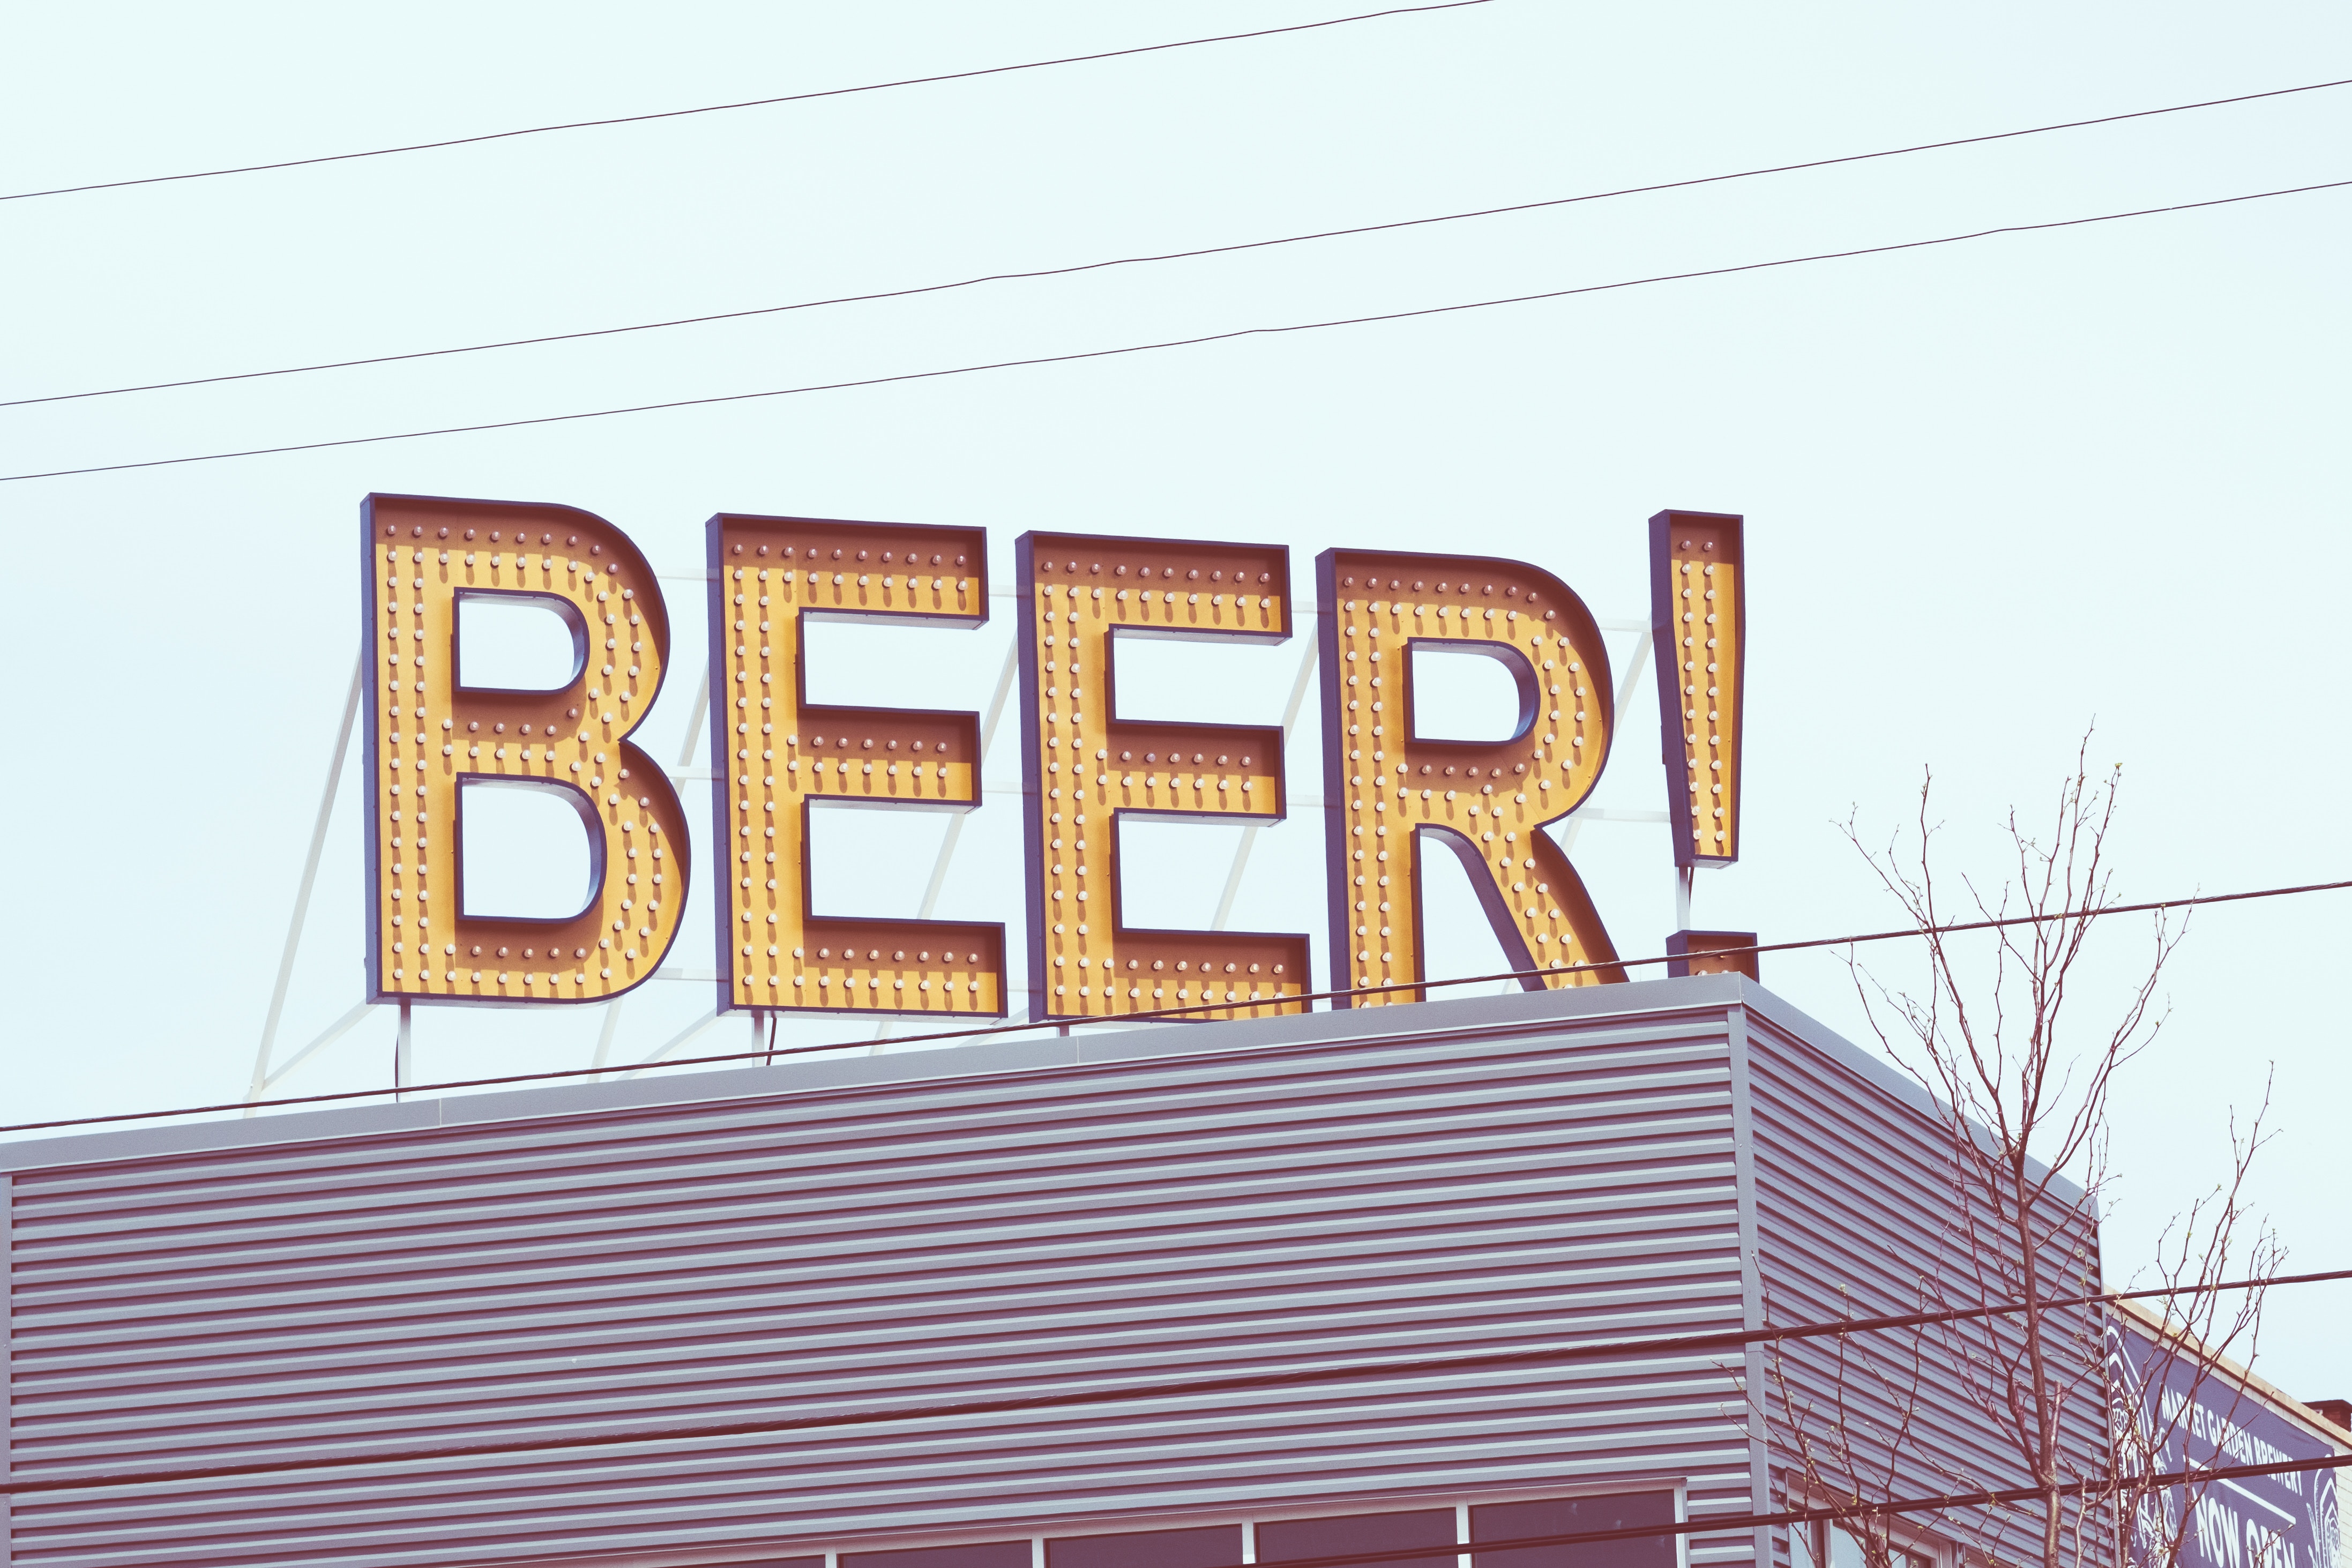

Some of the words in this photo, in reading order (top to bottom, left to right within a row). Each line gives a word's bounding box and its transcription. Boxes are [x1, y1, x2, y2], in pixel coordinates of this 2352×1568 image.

[360, 492, 1758, 1023] BEER!
[2160, 1382, 2206, 1440] MARKET
[2207, 1409, 2254, 1466] GARDEN
[2253, 1436, 2302, 1496] BREWERY
[2192, 1487, 2240, 1568] NOW
